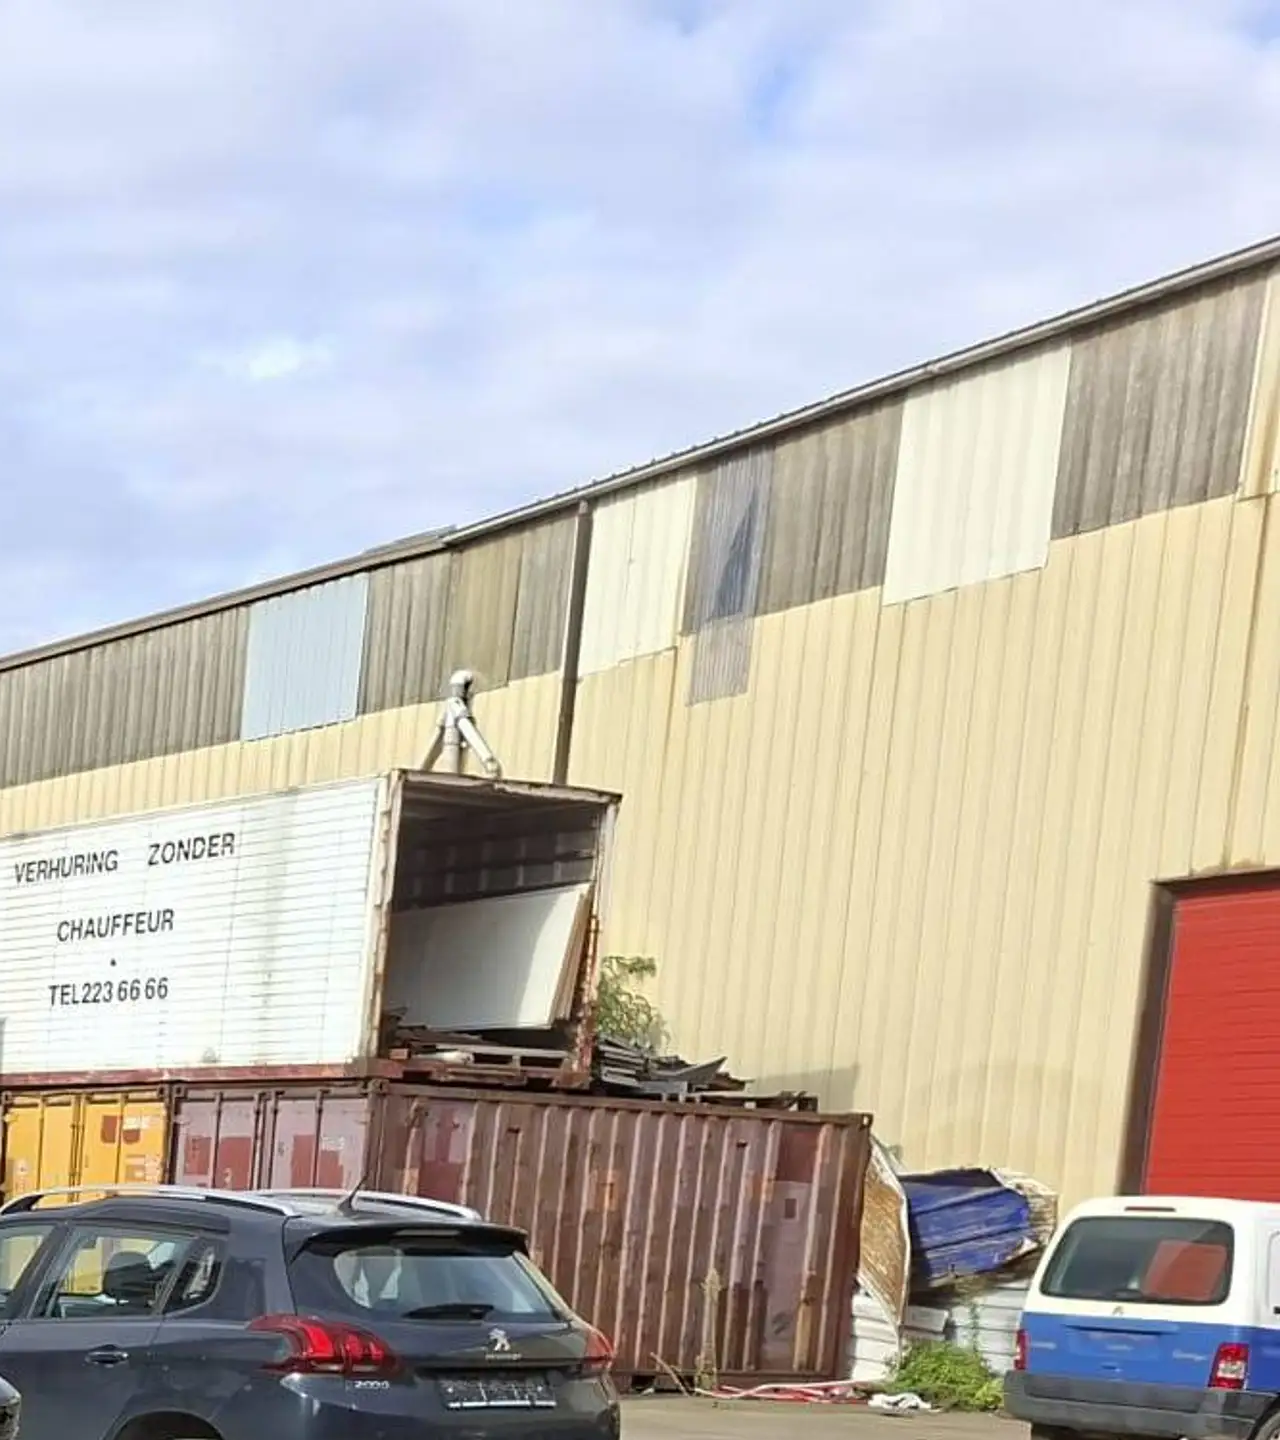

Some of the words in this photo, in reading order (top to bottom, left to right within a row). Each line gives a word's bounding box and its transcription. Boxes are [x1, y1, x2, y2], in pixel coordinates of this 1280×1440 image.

[14, 850, 119, 884] VERHURING
[147, 832, 235, 866] ZONDER
[57, 908, 174, 942] CHAUFFEUR
[117, 979, 140, 1002] 66
[145, 976, 168, 1000] 66
